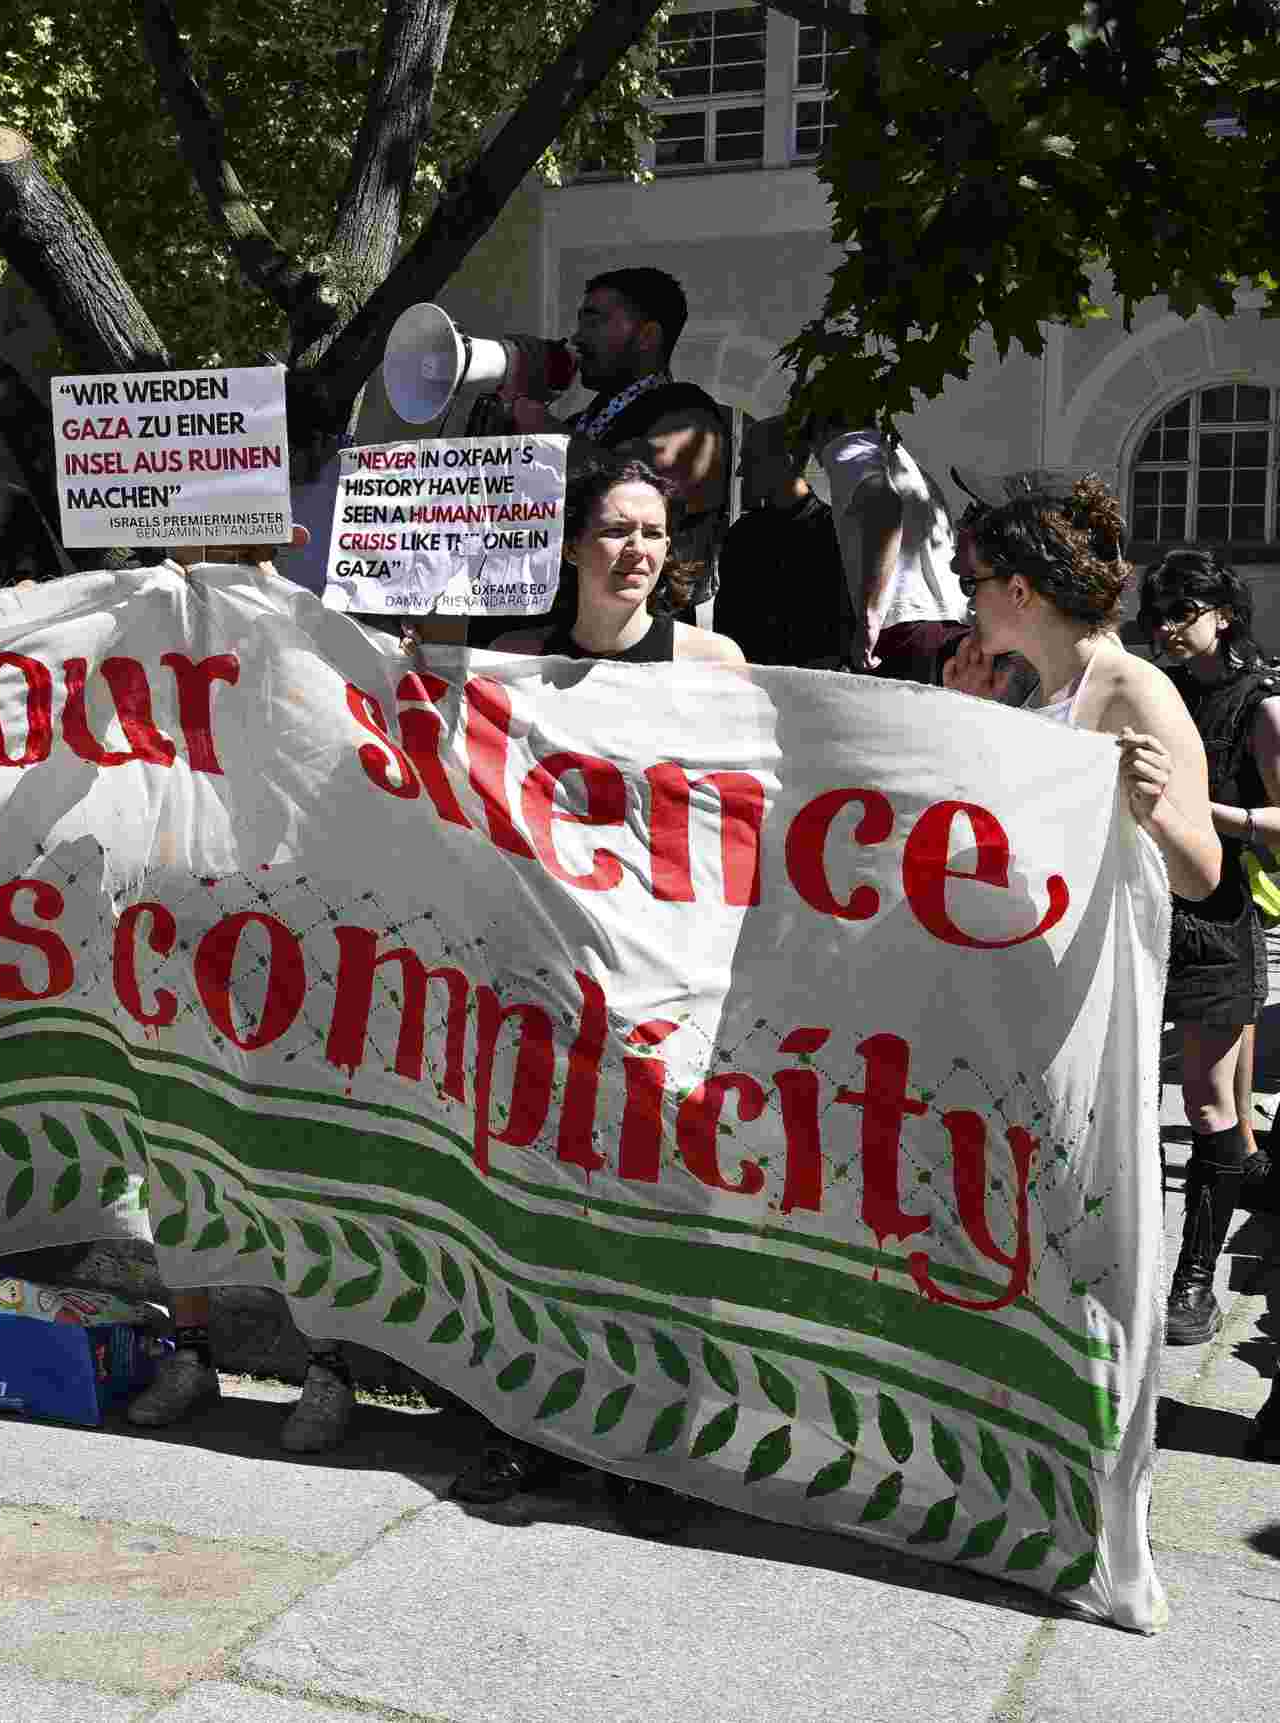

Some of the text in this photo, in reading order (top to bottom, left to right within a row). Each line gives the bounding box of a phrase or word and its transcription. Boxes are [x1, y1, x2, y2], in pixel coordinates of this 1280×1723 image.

[123, 377, 229, 404] WERDEN
[62, 411, 247, 441] GAZA ZU EINER
[64, 445, 281, 476] INSEL AUS RUINEN
[421, 450, 440, 469] IN
[345, 475, 515, 497] HISTORY HAVE WE
[110, 512, 283, 528] ISRAELS PREMIERMINISTER
[341, 502, 557, 524] SEEN A HUMANITARIAN
[338, 532, 398, 552] CRISIS
[401, 532, 440, 551] LIKE
[483, 530, 526, 550] ONE
[529, 530, 548, 549] IN
[472, 583, 547, 595] OXFAM CEO
[344, 671, 1071, 950] silence
[112, 900, 1041, 1311] complicity
